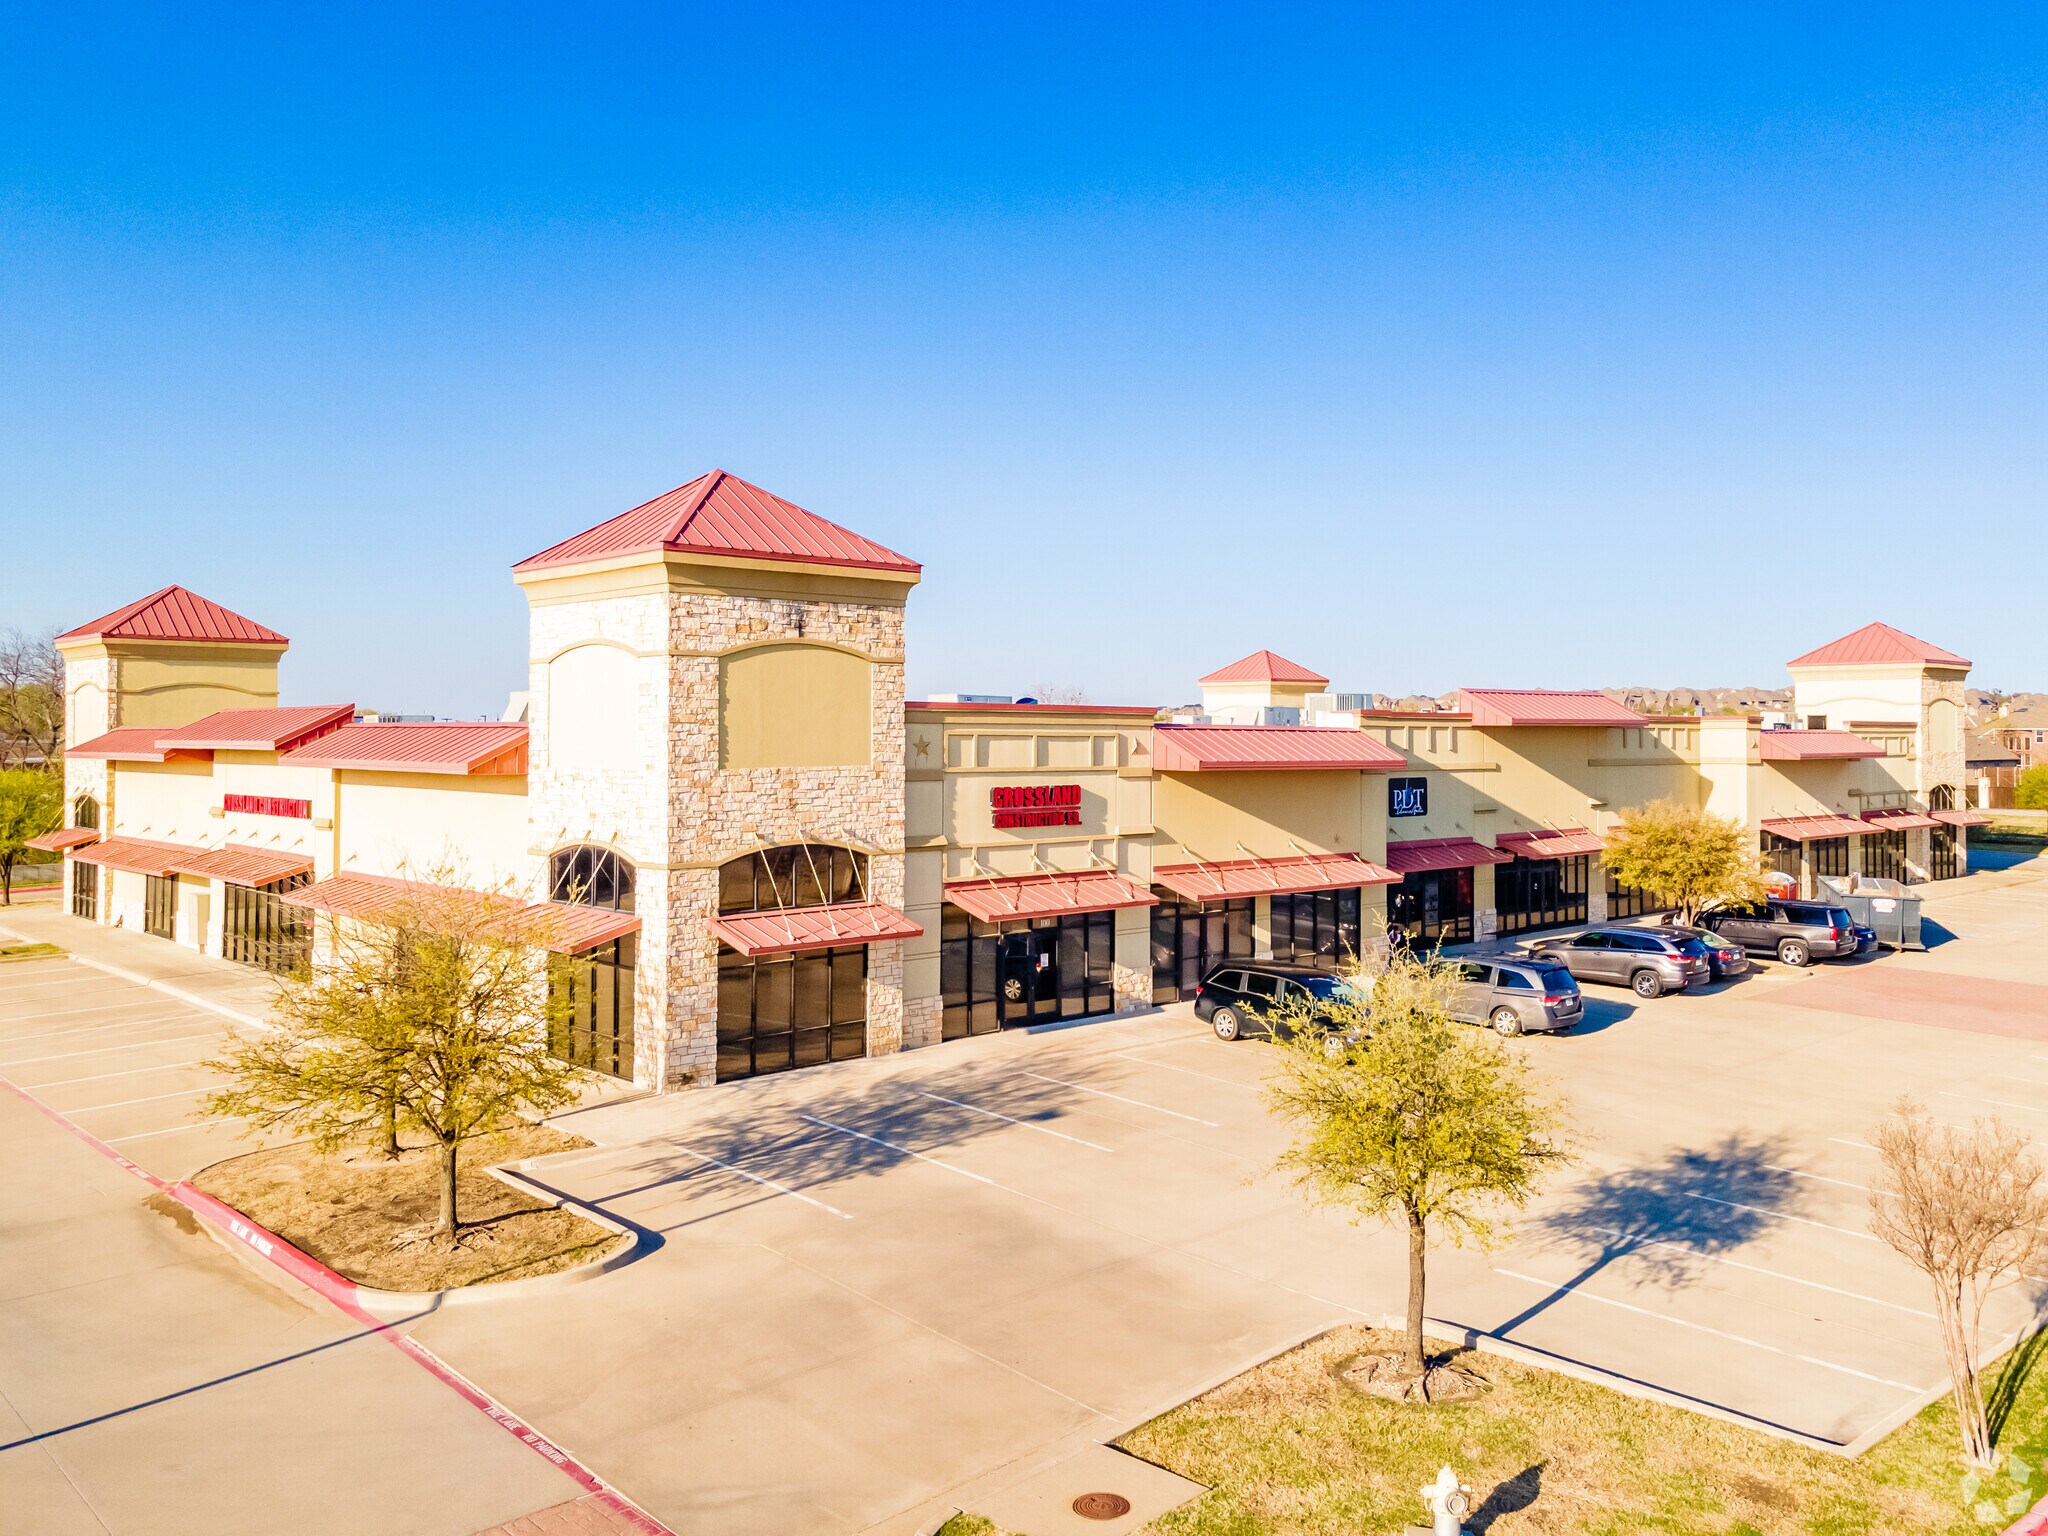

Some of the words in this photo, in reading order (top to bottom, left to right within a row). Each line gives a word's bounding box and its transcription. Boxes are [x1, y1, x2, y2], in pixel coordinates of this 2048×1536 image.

[992, 784, 1081, 808] CROSSLAND
[994, 811, 1064, 828] CONSTRUCTION
[1041, 919, 1050, 927] 100
[521, 1432, 539, 1443] NO
[532, 1440, 568, 1464] PARKING
